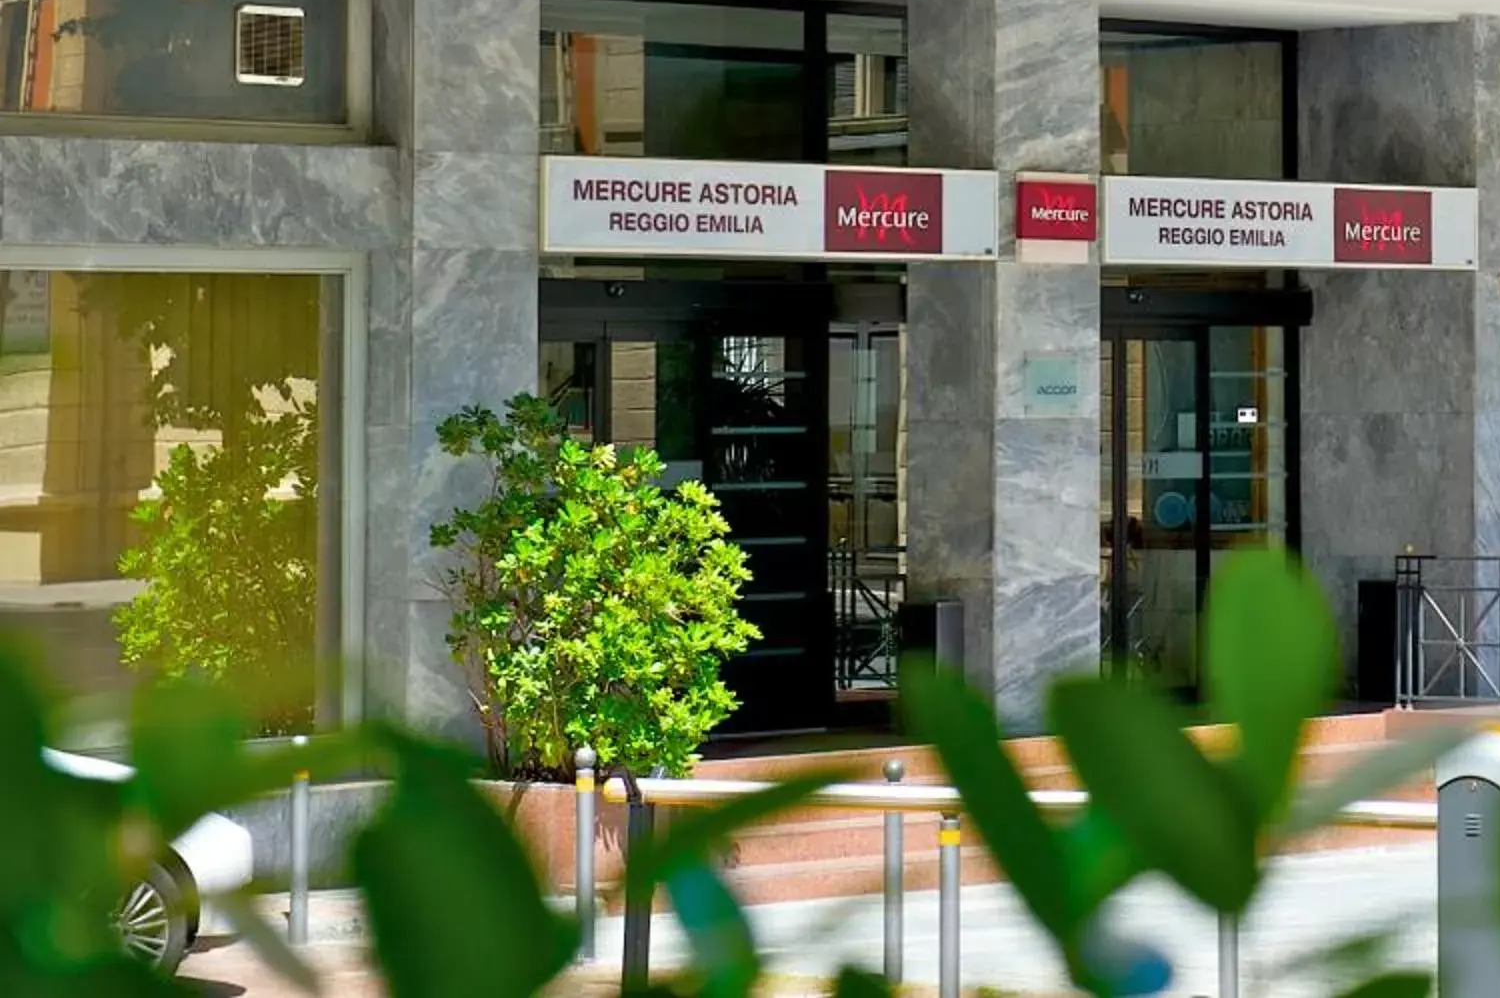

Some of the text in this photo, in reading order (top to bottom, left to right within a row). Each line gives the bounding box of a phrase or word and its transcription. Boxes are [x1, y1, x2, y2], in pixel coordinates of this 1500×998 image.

[573, 179, 798, 207] MERCURE ASTORIA
[837, 206, 930, 229] Mercure
[1031, 206, 1090, 223] Mercure
[1128, 198, 1314, 222] MERCURE ASTORIA
[609, 212, 764, 235] REGGIO EMILIA
[1345, 222, 1422, 242] Mercure
[1158, 227, 1286, 248] REGGIO EMILIA
